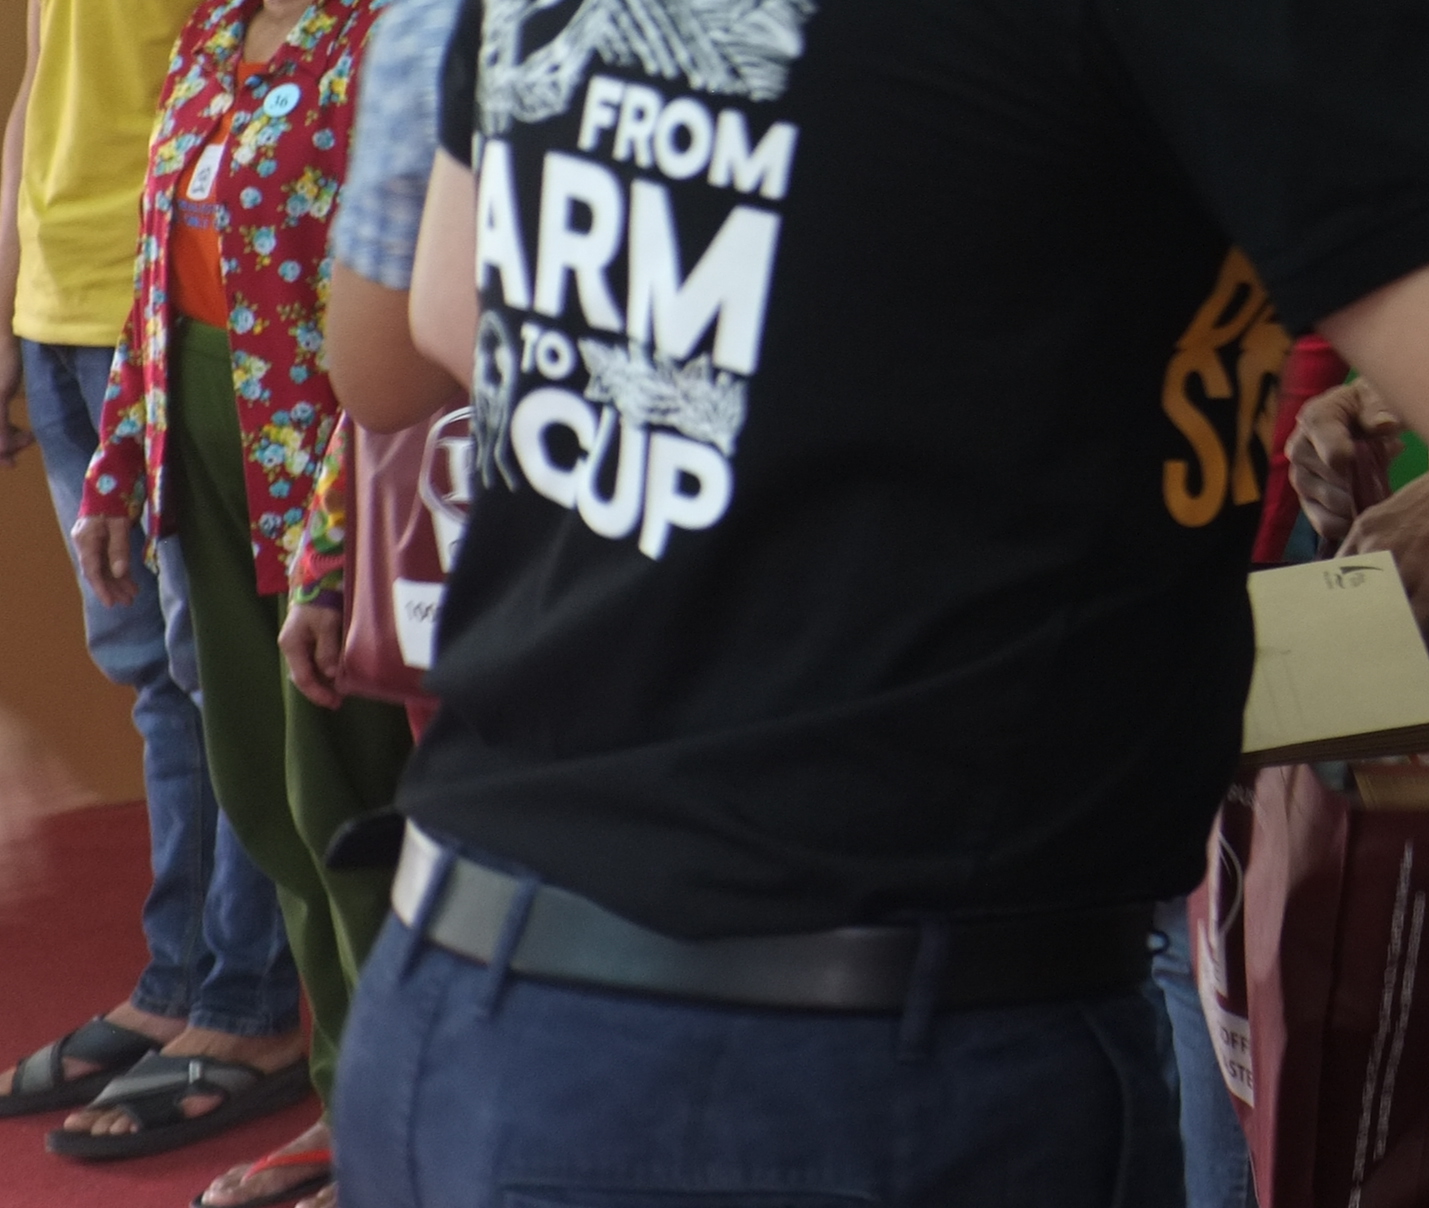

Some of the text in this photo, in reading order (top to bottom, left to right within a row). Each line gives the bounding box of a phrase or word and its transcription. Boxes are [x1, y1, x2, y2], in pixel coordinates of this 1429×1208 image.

[577, 75, 798, 200] FROM
[474, 134, 782, 376] ARM
[520, 321, 575, 380] TO
[510, 387, 733, 561] CUP
